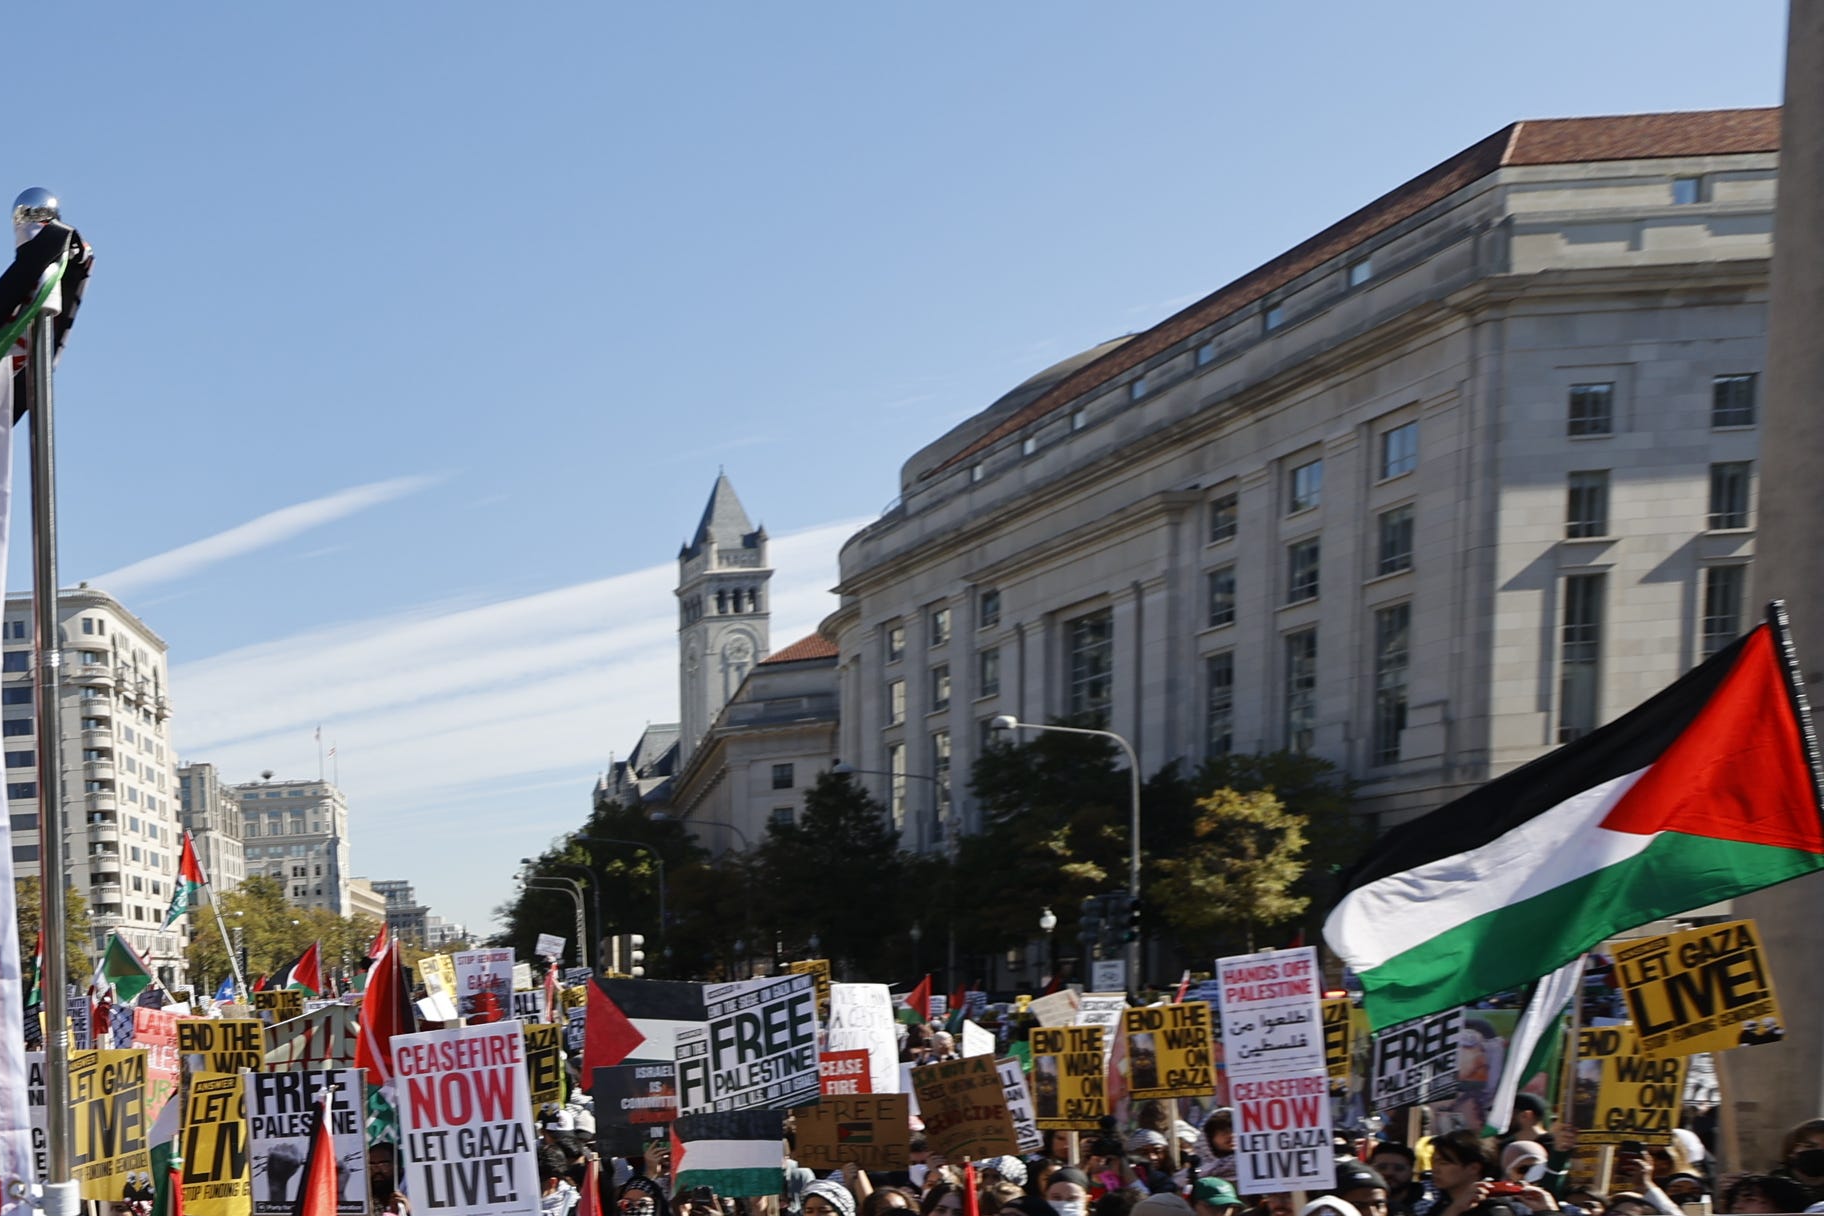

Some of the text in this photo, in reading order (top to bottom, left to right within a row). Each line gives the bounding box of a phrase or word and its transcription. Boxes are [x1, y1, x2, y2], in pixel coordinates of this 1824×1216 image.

[1620, 923, 1756, 987] LET GAZA
[1223, 959, 1312, 986] HANDS OFF
[1226, 978, 1312, 1004] PALESTINE
[1629, 949, 1769, 1037] LIVE!
[709, 991, 813, 1072] FREE
[1127, 1009, 1163, 1032] END
[1169, 1005, 1206, 1028] THE
[179, 1023, 214, 1051] END
[219, 1022, 260, 1050] THE
[1033, 1028, 1101, 1054] END THE
[1164, 1028, 1207, 1050] WAR
[1237, 1033, 1309, 1059] فلسطين
[1378, 1010, 1461, 1078] FREE
[1578, 1030, 1620, 1058] END
[397, 1032, 521, 1076] CEASEFIRE
[1064, 1053, 1103, 1076] WAR
[1185, 1049, 1209, 1067] ON
[102, 1054, 145, 1096] GAZA
[635, 1066, 675, 1080] ISRAEL
[820, 1058, 864, 1077] CEASE
[1166, 1068, 1211, 1087] GAZA
[1615, 1055, 1680, 1083] WAR
[195, 1077, 236, 1094] ANSWER
[254, 1068, 349, 1115] FREE
[408, 1066, 516, 1129] NOW
[826, 1079, 860, 1095] FIRE
[1081, 1077, 1104, 1097] ON
[1233, 1075, 1325, 1101] CEASEFIRE
[1638, 1084, 1676, 1108] ON
[190, 1093, 233, 1125] LET
[817, 1098, 897, 1121] FREE
[1065, 1098, 1104, 1119] GAZA
[1240, 1096, 1321, 1133] NOW
[1605, 1107, 1671, 1132] GAZA
[407, 1122, 530, 1163] LET GAZA
[1239, 1128, 1329, 1153] LET GAZA
[1250, 1149, 1320, 1180] LIVE!
[424, 1157, 518, 1209] LIVE!
